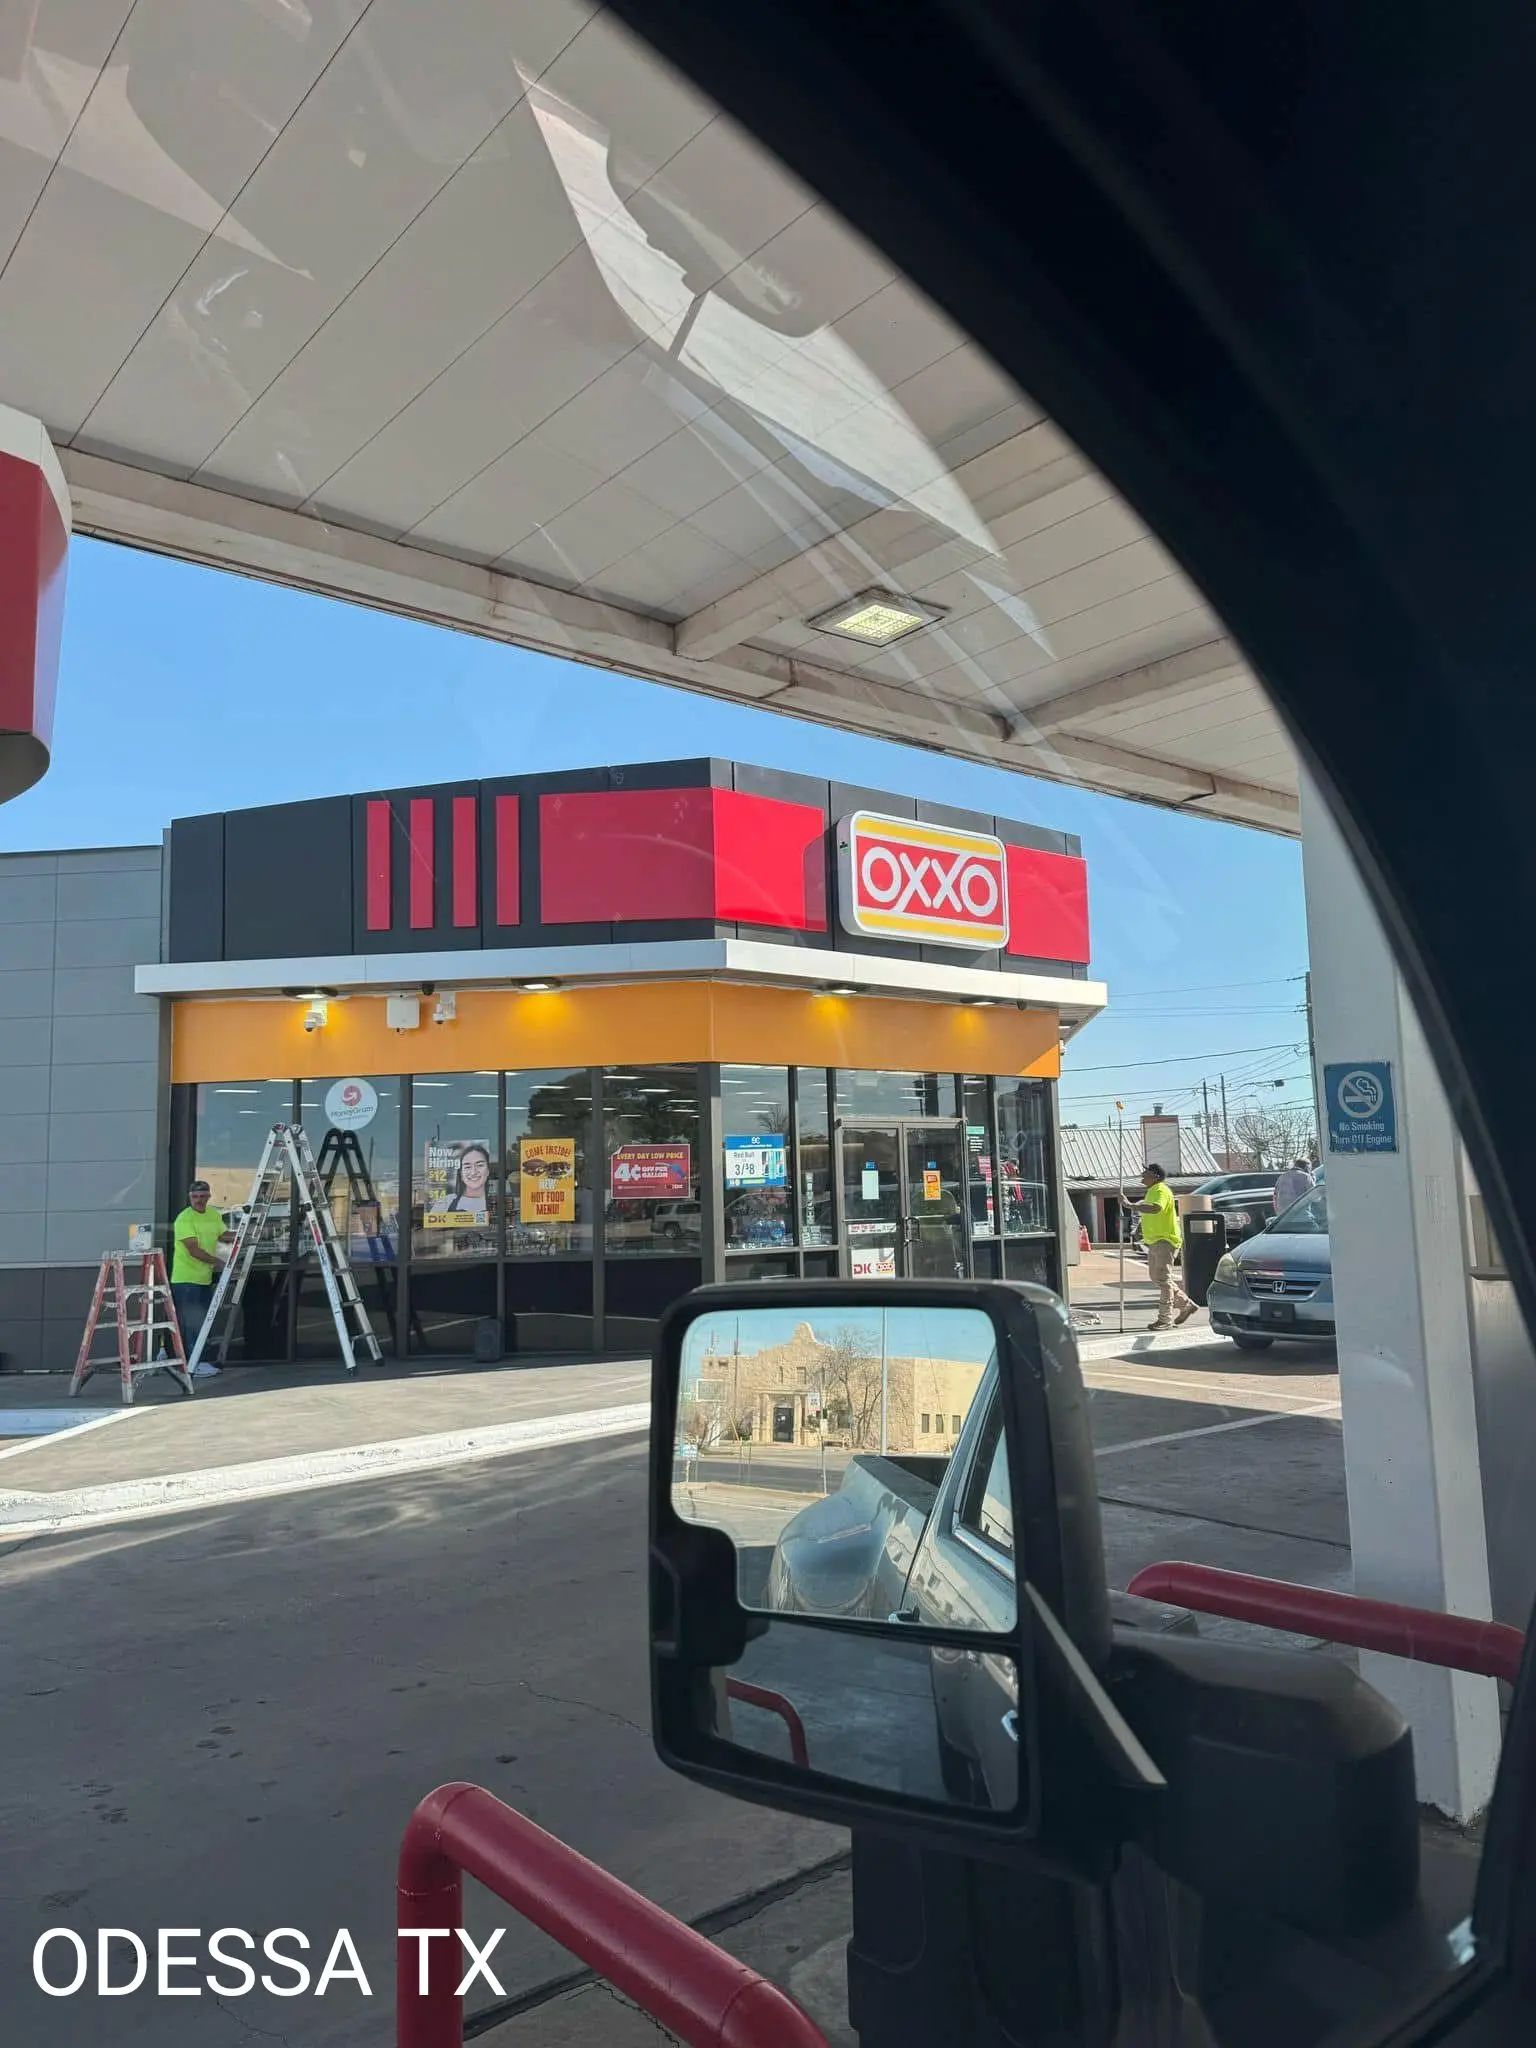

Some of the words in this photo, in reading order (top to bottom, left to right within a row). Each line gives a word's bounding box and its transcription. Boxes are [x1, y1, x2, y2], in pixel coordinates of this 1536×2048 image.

[862, 847, 998, 918] OXXO
[1339, 1122, 1350, 1131] No
[1351, 1121, 1385, 1132] Smoking
[1335, 1134, 1350, 1144] Turn
[1351, 1134, 1364, 1144] Off
[1366, 1134, 1392, 1145] Engine
[429, 1147, 453, 1157] Now
[525, 1144, 544, 1158] COME
[617, 1152, 635, 1160] EVERY
[637, 1152, 650, 1160] DAY
[666, 1151, 684, 1159] PRICE
[429, 1157, 460, 1169] Hiring
[614, 1163, 641, 1182] 4¢
[531, 1191, 545, 1202] HOT
[546, 1191, 565, 1203] FOOD
[428, 1215, 447, 1224] DK
[853, 1263, 872, 1275] DK
